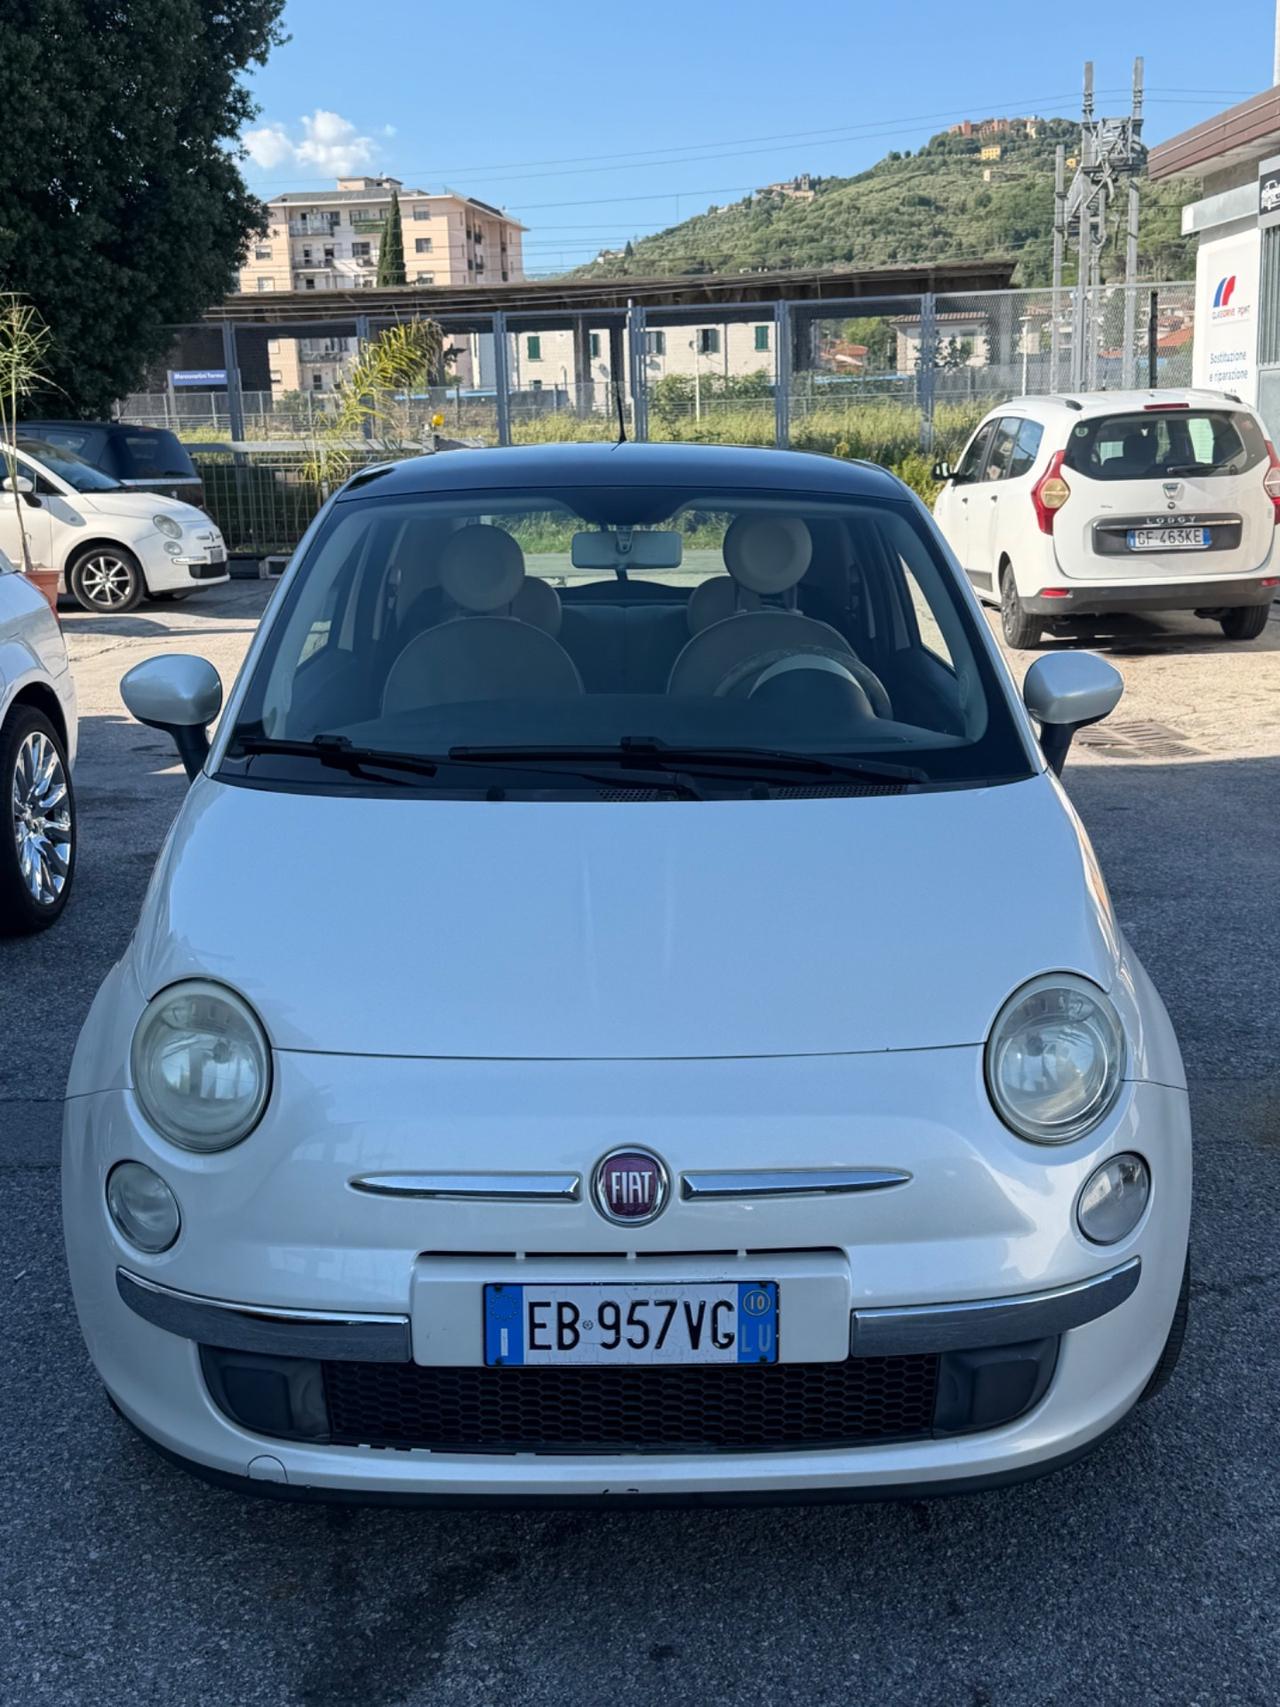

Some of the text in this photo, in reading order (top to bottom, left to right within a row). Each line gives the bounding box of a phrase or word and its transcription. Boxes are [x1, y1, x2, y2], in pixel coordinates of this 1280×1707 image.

[1210, 351, 1247, 365] Sostituzione
[611, 1171, 652, 1204] FIAT
[528, 1301, 580, 1350] EB
[597, 1300, 736, 1350] 957VG
[741, 1324, 771, 1353] LU
